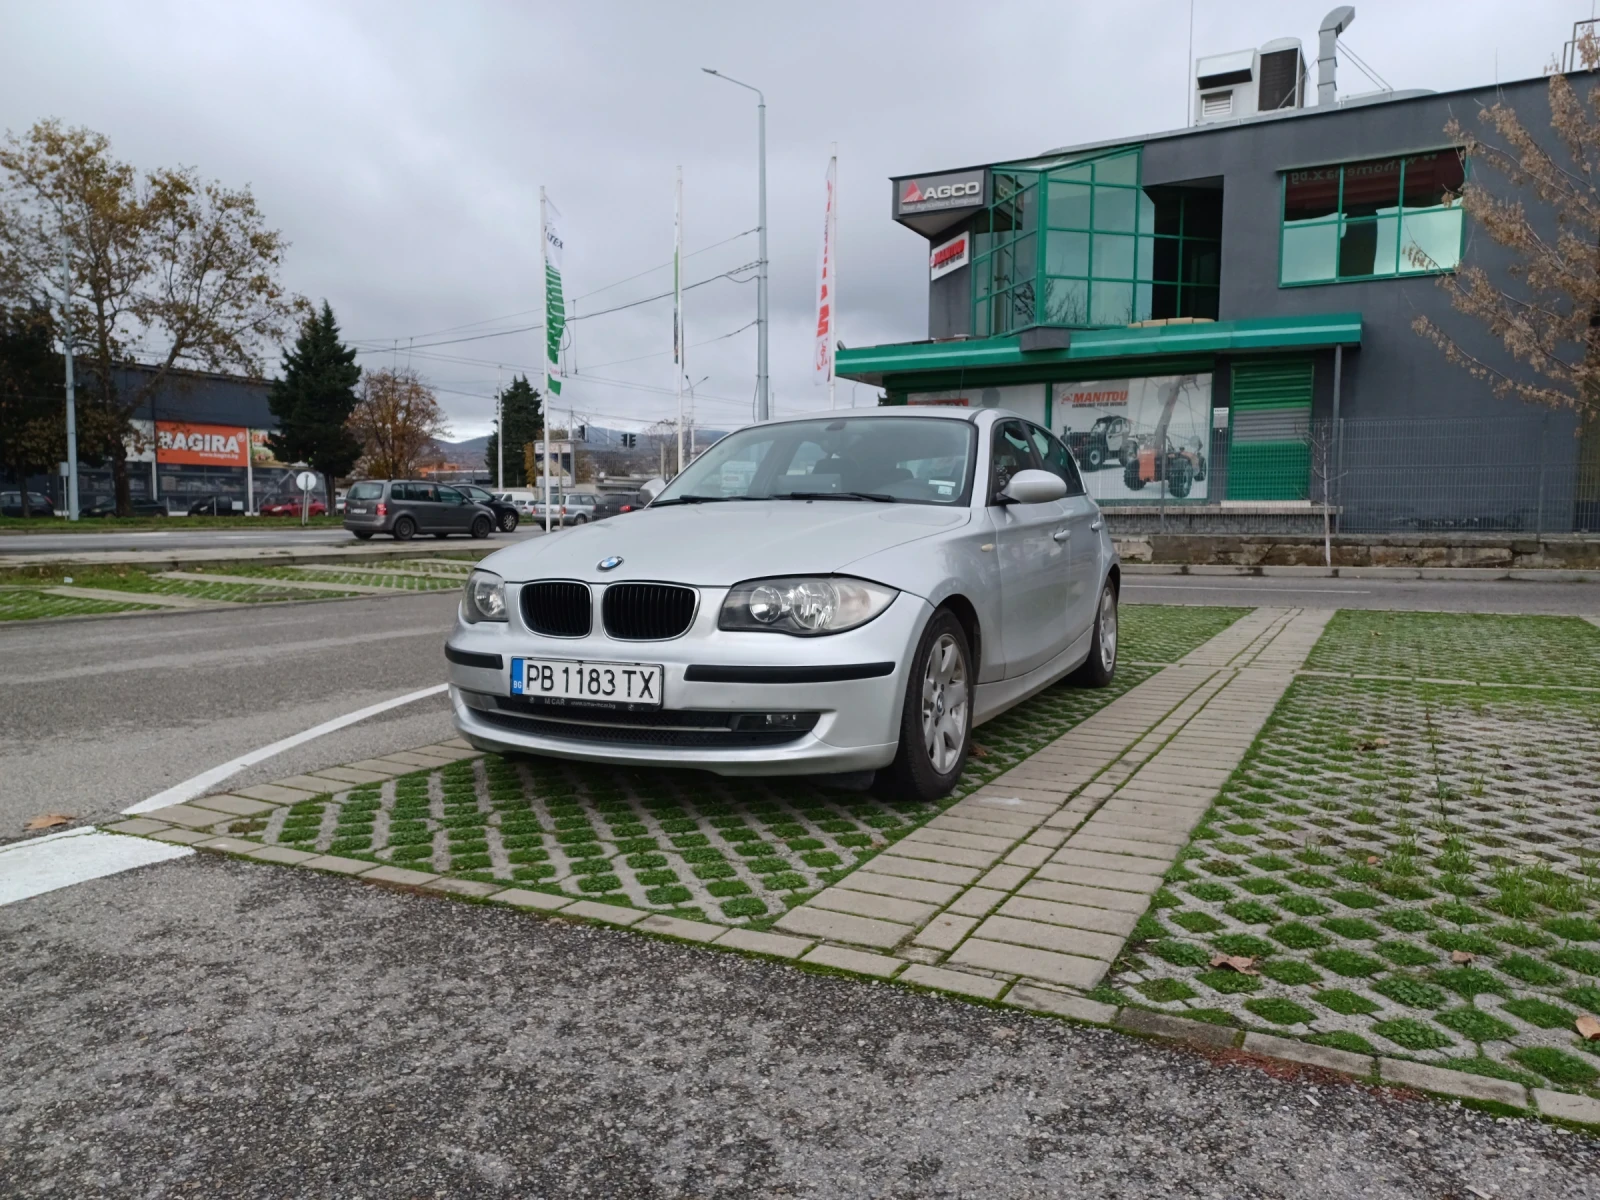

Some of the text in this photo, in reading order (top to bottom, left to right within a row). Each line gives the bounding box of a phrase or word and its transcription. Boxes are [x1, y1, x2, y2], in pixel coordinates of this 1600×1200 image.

[923, 181, 980, 200] AGCO
[916, 201, 949, 211] Agriculture
[950, 196, 980, 206] Company
[1073, 391, 1128, 403] MANITOU
[158, 431, 240, 454] BAGIRA
[513, 680, 523, 689] BG
[526, 664, 655, 699] PB 1183 TX
